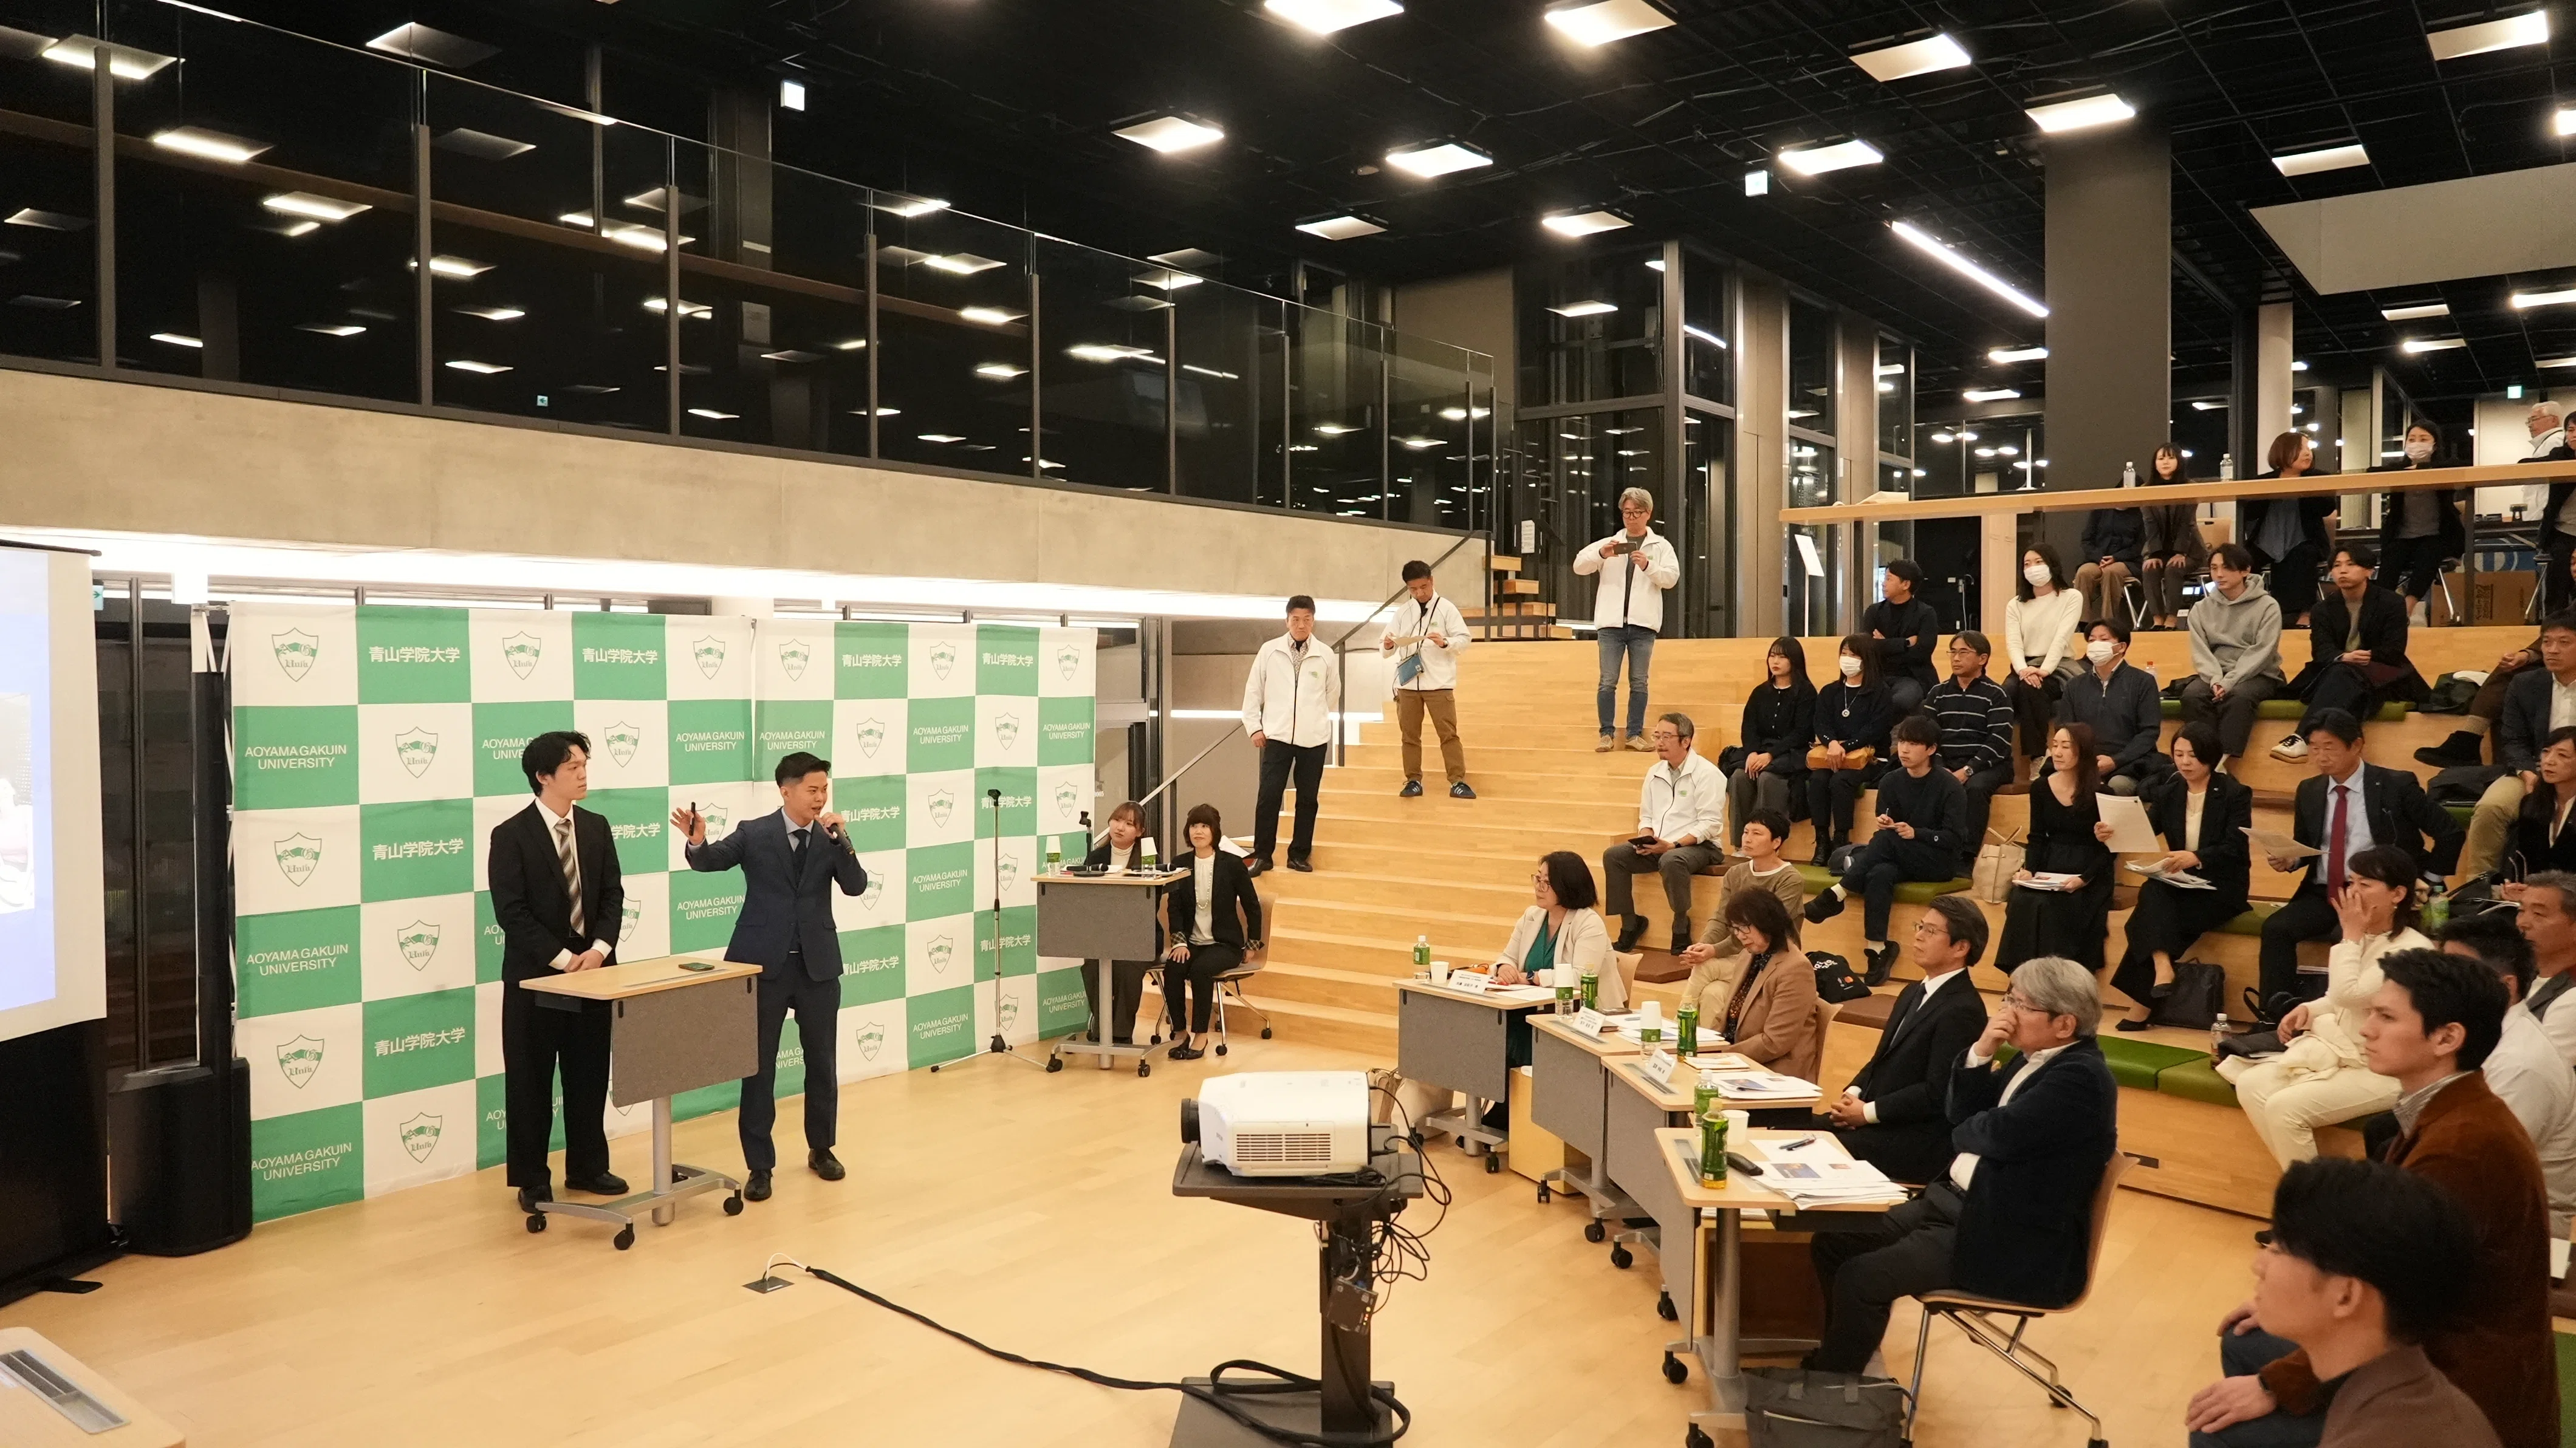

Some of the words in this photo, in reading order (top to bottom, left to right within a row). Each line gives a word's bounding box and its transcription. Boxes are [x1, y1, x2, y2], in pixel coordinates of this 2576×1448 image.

[369, 646, 461, 663] 青山学院大学
[582, 648, 657, 664] 青山学院大学
[842, 654, 902, 667] 青山学院大学
[982, 653, 1033, 666] 青山学院大学
[676, 733, 711, 741] AOYAMA
[713, 731, 744, 740] GAKUIN
[759, 732, 793, 740] AOYAMA
[794, 731, 825, 740] GAKUIN
[913, 726, 941, 735] AOYAMA
[942, 725, 969, 734] GAKUIN
[1049, 730, 1084, 739] UNIVERSITY
[482, 738, 525, 749] AOYAMA
[685, 741, 736, 752] UNIVERSITY
[767, 741, 818, 751] UNIVERSITY
[920, 734, 962, 745] UNIVERSITY
[245, 746, 298, 757] AOYAMA
[299, 745, 347, 756] GAKUIN
[493, 749, 524, 760] UNIVE
[258, 757, 335, 770] UNIVERSITY
[841, 806, 900, 822] 青山学院大学
[611, 822, 661, 839] 学院大学
[373, 838, 464, 861] 青山学院大学
[1066, 856, 1085, 866] GAKUI
[912, 873, 941, 884] AOYAMA
[942, 869, 968, 879] GAKUIN
[919, 879, 961, 892] UNIVERSITY
[677, 900, 712, 910] AOYAMA
[712, 895, 745, 907] GAKUIN
[685, 906, 737, 920] UNIVERSITY
[247, 950, 300, 965] AOYAMA
[301, 944, 348, 958] GAKUIN
[260, 958, 336, 976] UNIVERSITY
[1043, 994, 1067, 1006] AOYAMA
[1067, 991, 1086, 1002] GAKUI
[1049, 999, 1084, 1013] UNIVERSITY
[913, 1019, 941, 1032] AOYAMA
[942, 1013, 968, 1025] GAKUIN
[920, 1023, 962, 1040] UNIVERSITY
[375, 1026, 465, 1056] 青山学院大学
[252, 1152, 303, 1170] AOYAMA
[304, 1142, 352, 1159] GAKUIN
[264, 1157, 341, 1181] UNIVERSITY
